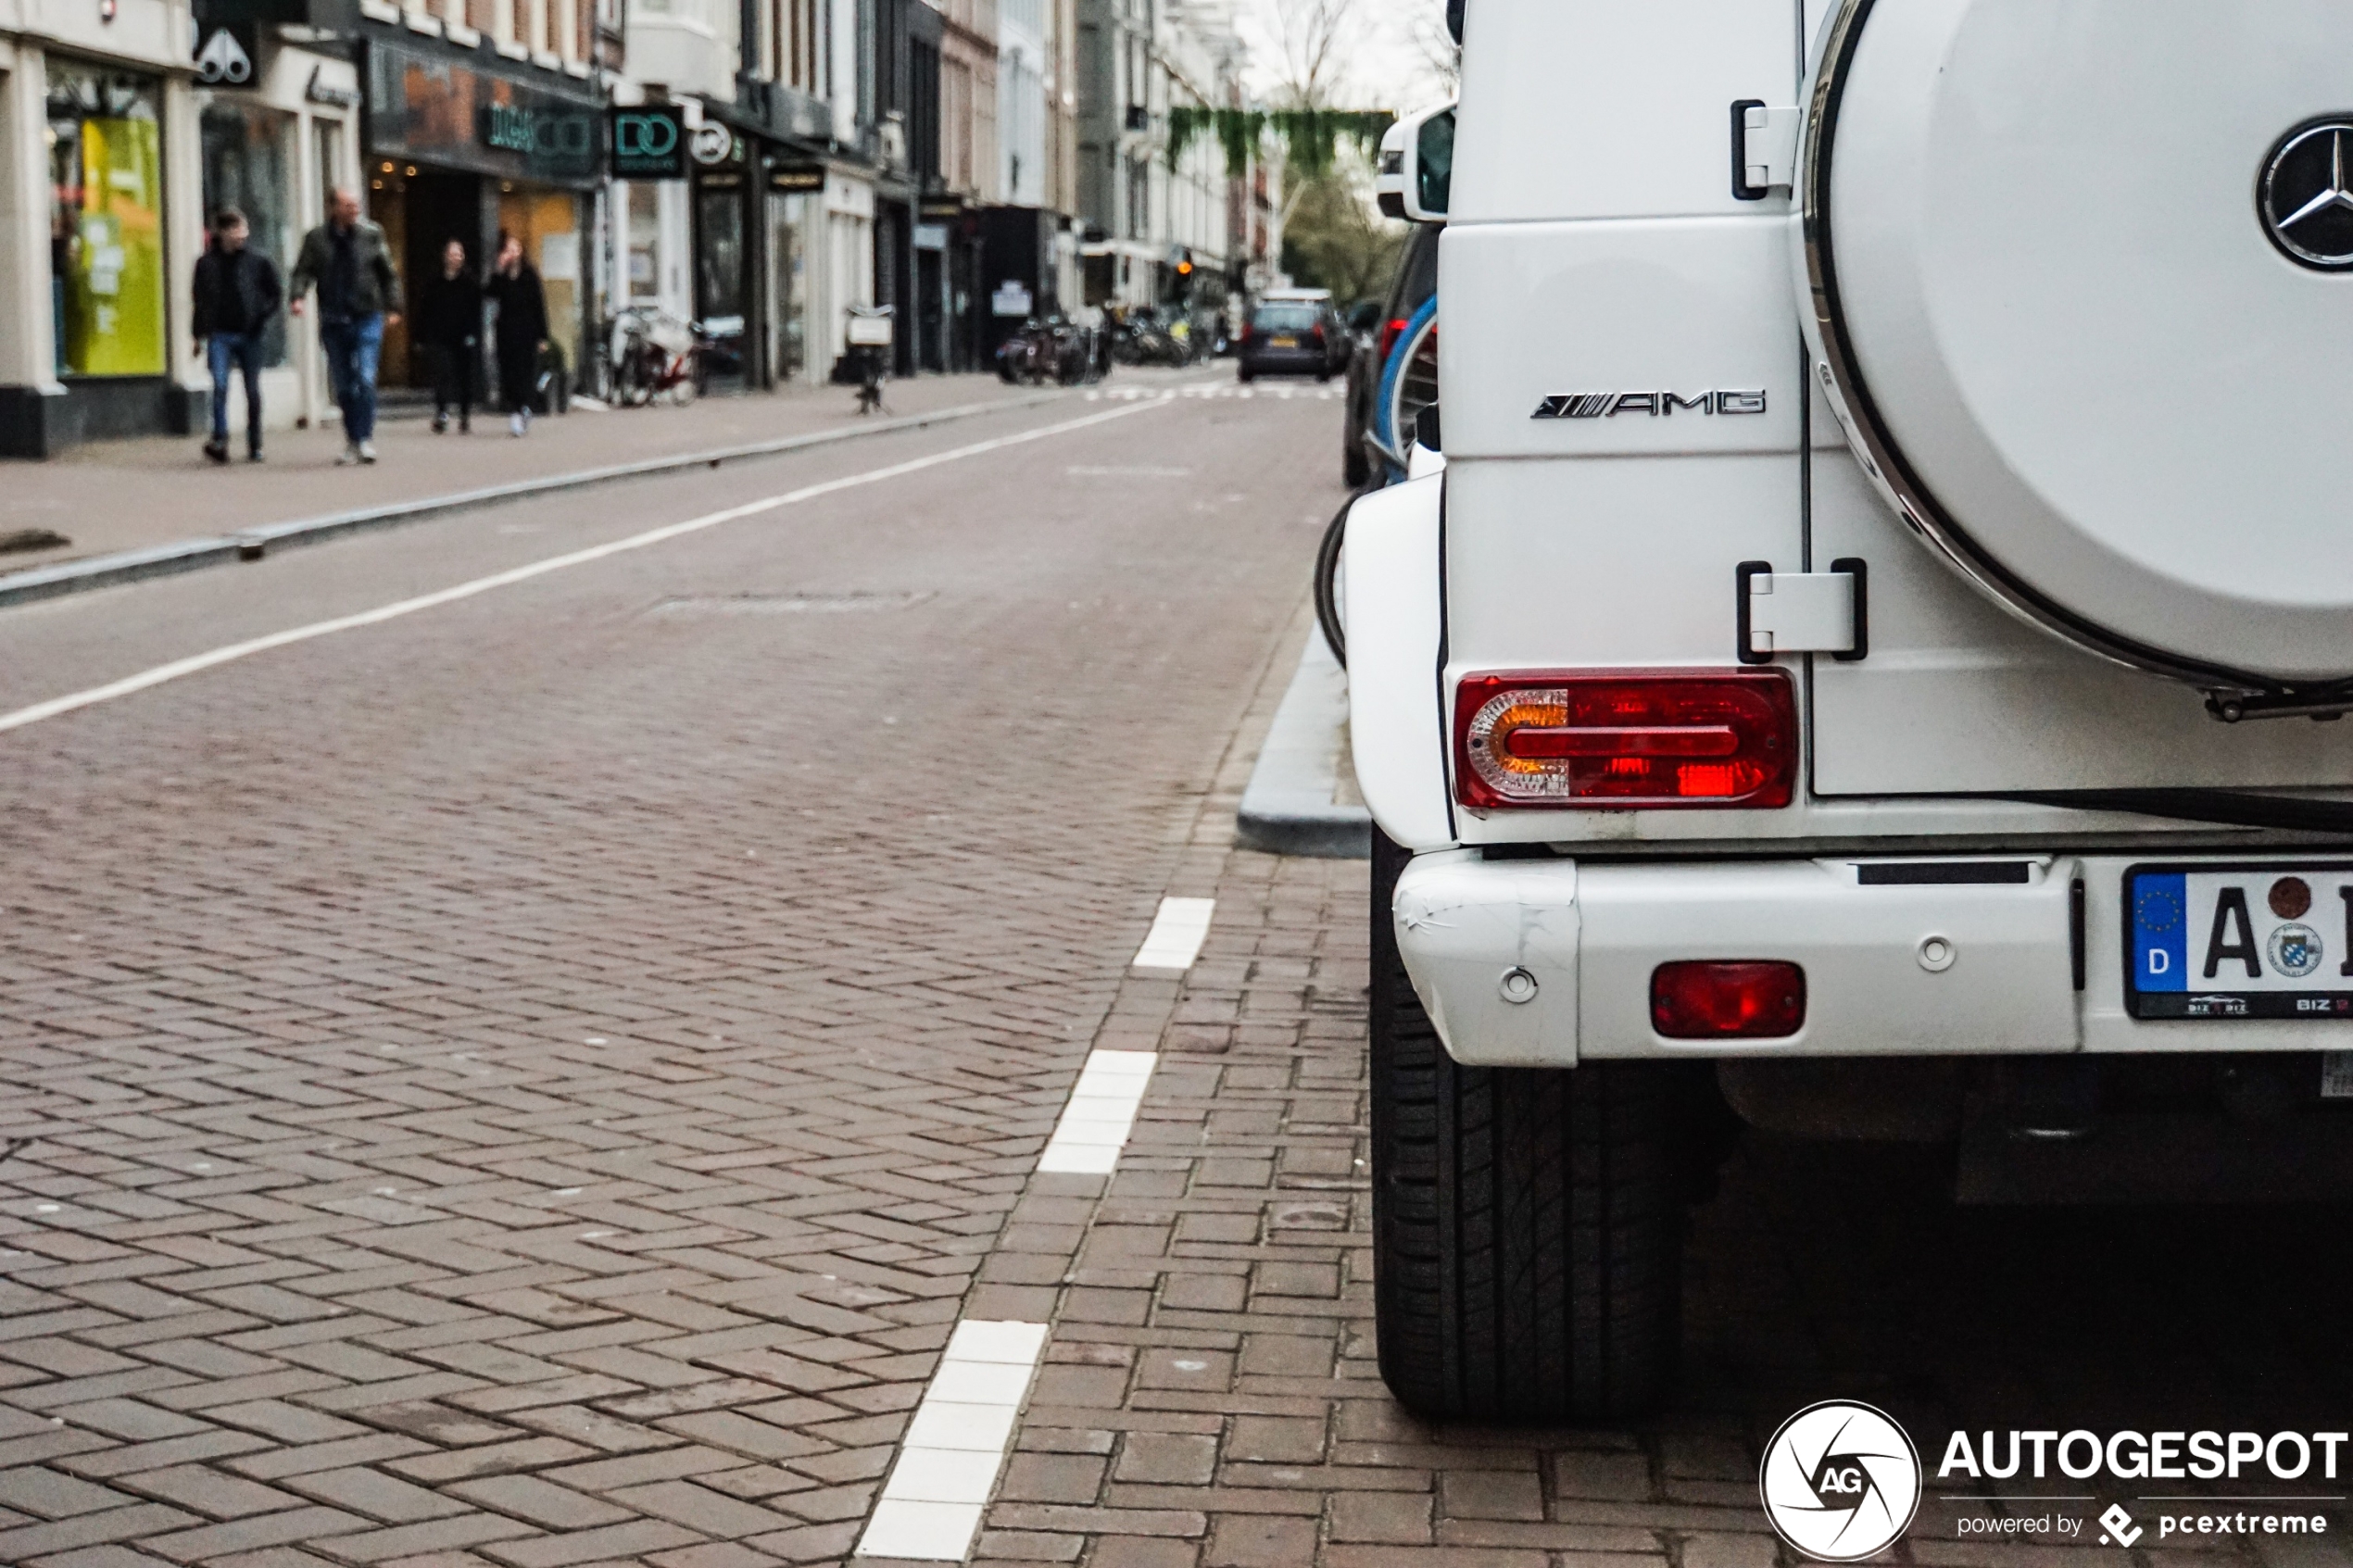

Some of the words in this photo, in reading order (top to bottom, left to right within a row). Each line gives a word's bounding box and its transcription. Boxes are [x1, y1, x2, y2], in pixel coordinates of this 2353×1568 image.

[616, 114, 677, 156] DO
[1605, 389, 1766, 416] AMG
[2203, 886, 2261, 977] A
[2148, 948, 2169, 974] D
[2296, 999, 2331, 1011] BIZ
